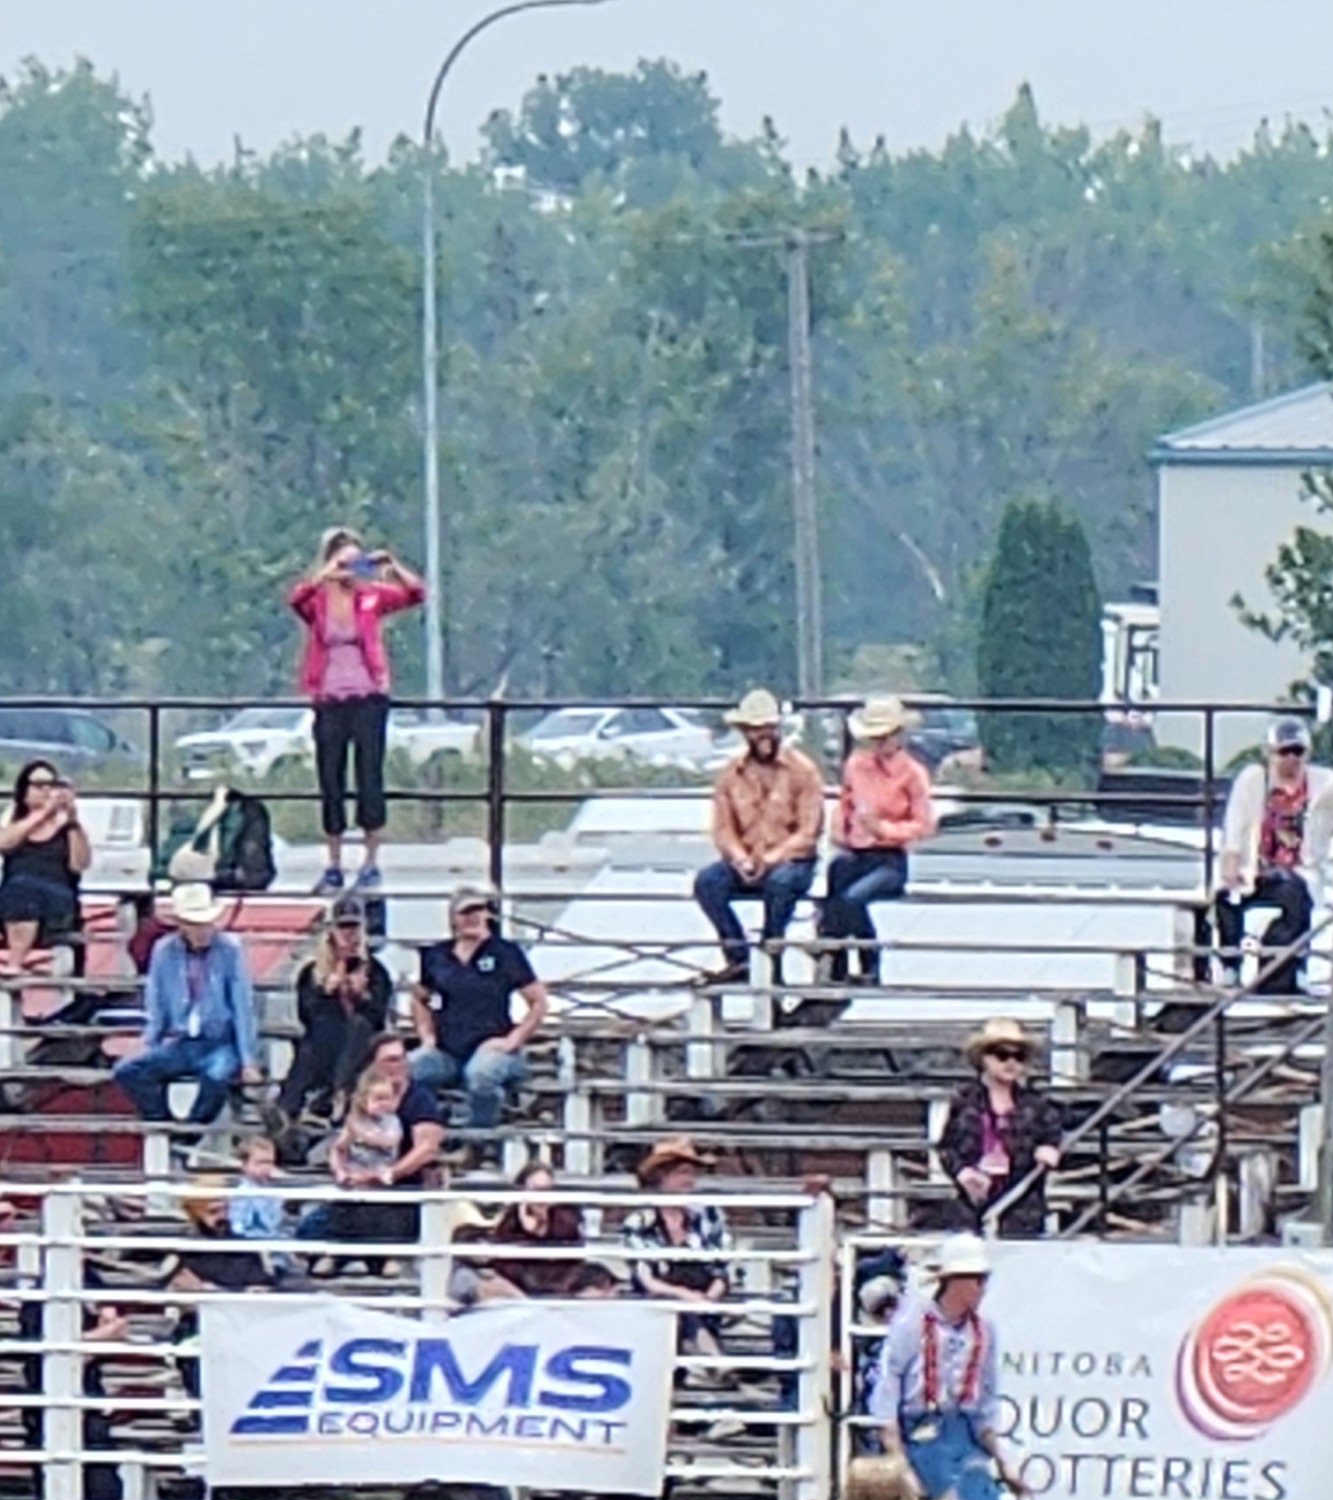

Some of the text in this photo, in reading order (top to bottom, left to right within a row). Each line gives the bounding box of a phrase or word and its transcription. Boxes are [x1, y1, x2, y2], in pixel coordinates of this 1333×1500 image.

[323, 1337, 633, 1411] SMS
[1002, 1351, 1154, 1378] NITOBA
[317, 1411, 628, 1445] EQUIPMENT
[996, 1395, 1150, 1445] QUOR
